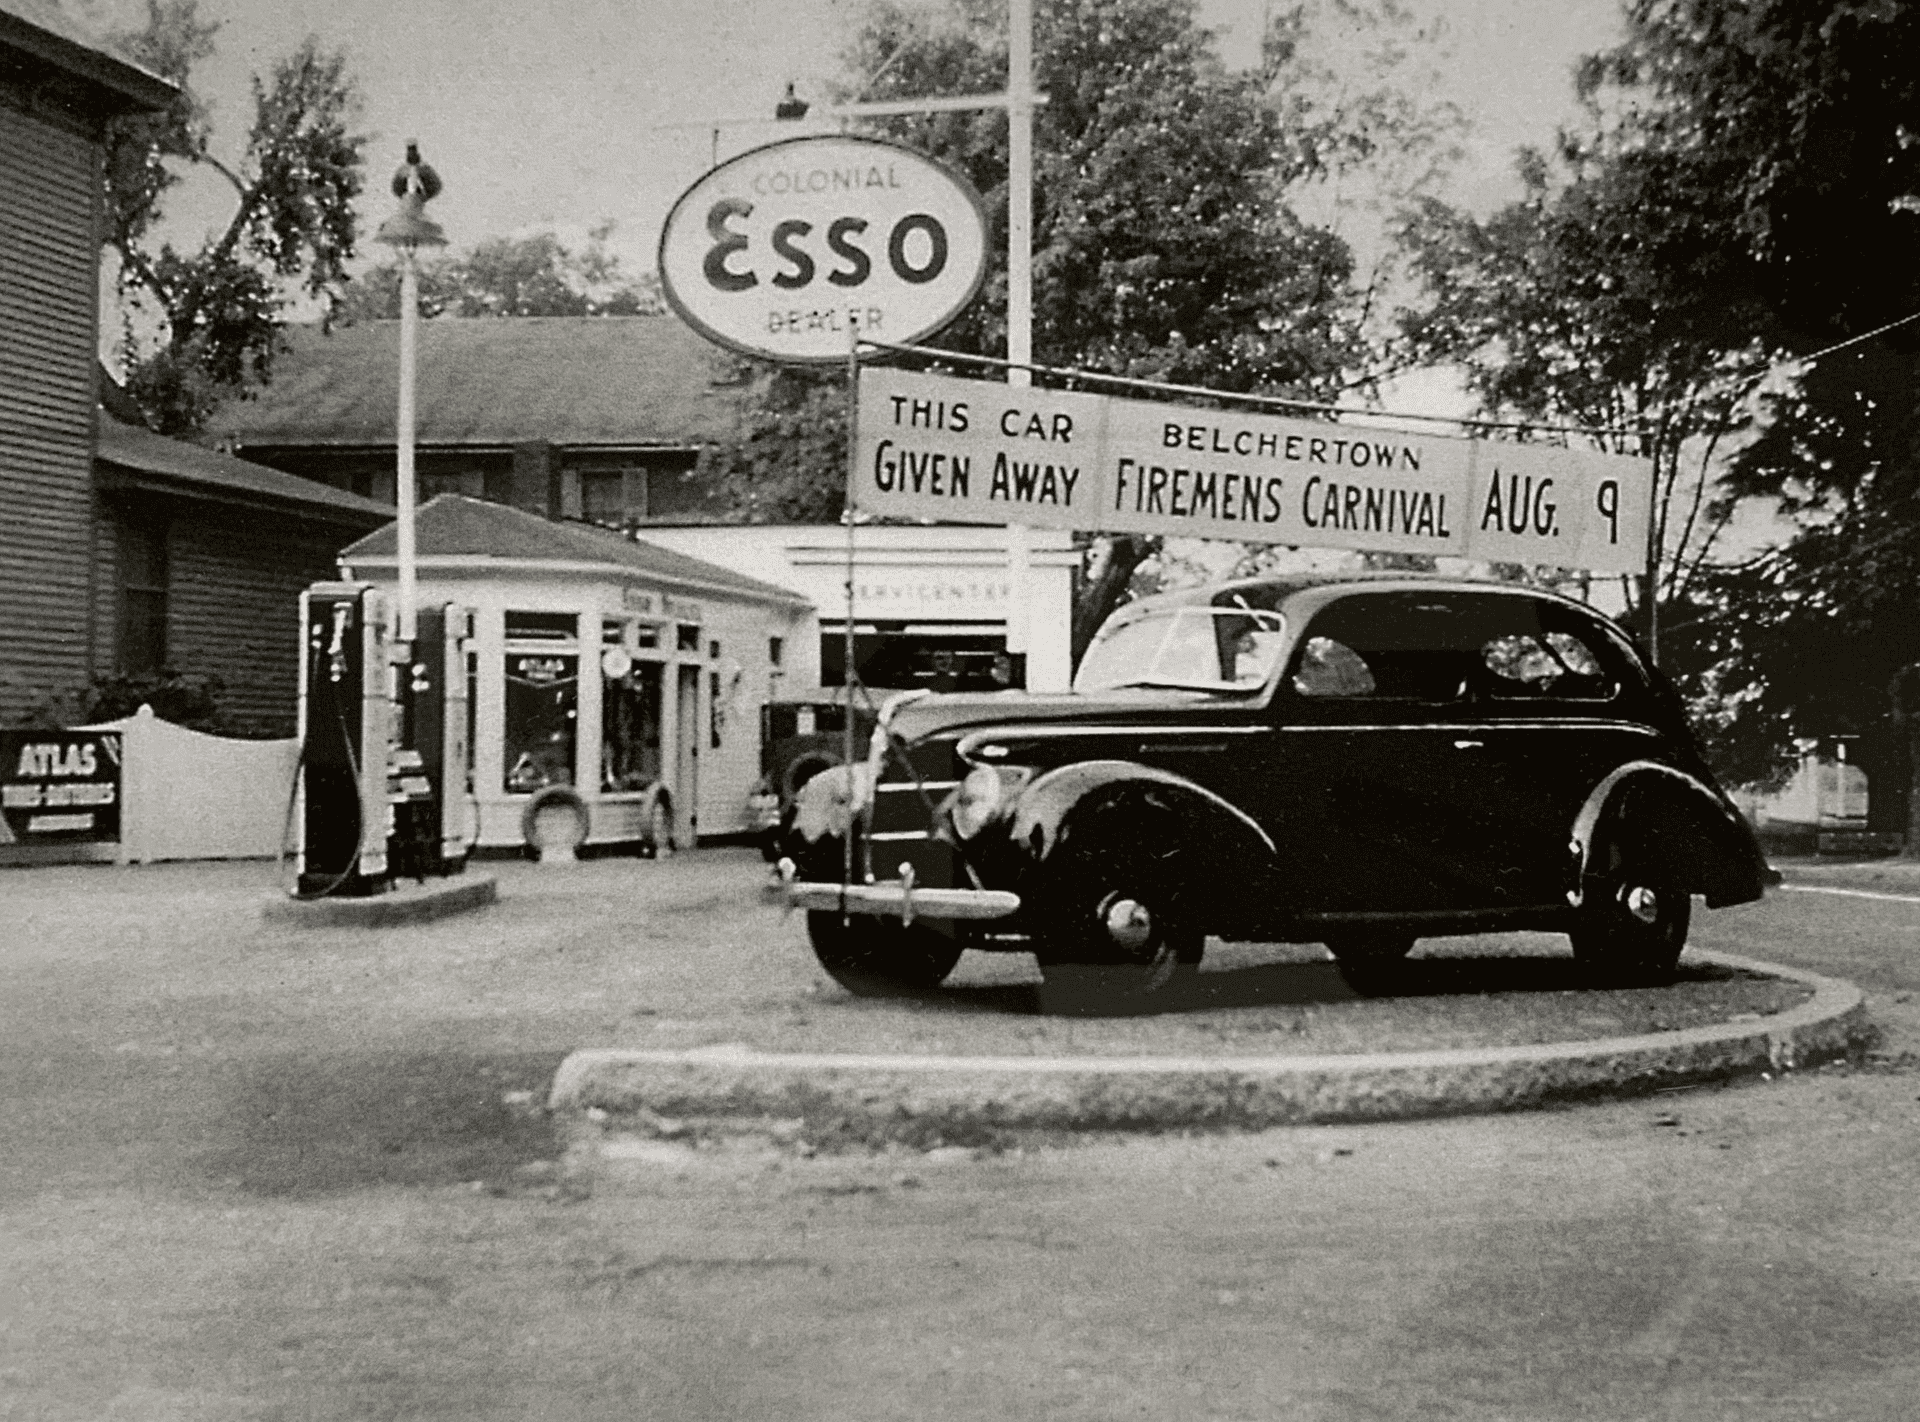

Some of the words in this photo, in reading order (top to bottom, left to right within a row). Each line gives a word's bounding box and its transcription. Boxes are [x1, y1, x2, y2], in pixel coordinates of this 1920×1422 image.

[754, 166, 901, 195] COLONIAL
[768, 307, 883, 333] DEALER
[890, 396, 969, 432] THIS
[1000, 409, 1073, 443] CAR
[1163, 423, 1422, 471] BELCHERTOWN
[874, 439, 970, 498] GIVEN
[990, 451, 1080, 506] AWAY
[1115, 458, 1283, 523] FIREMENS
[1303, 476, 1450, 538] CARNIVAL
[1481, 468, 1560, 537] AUG.
[1597, 479, 1618, 544] 9
[17, 743, 97, 776] ATLAS
